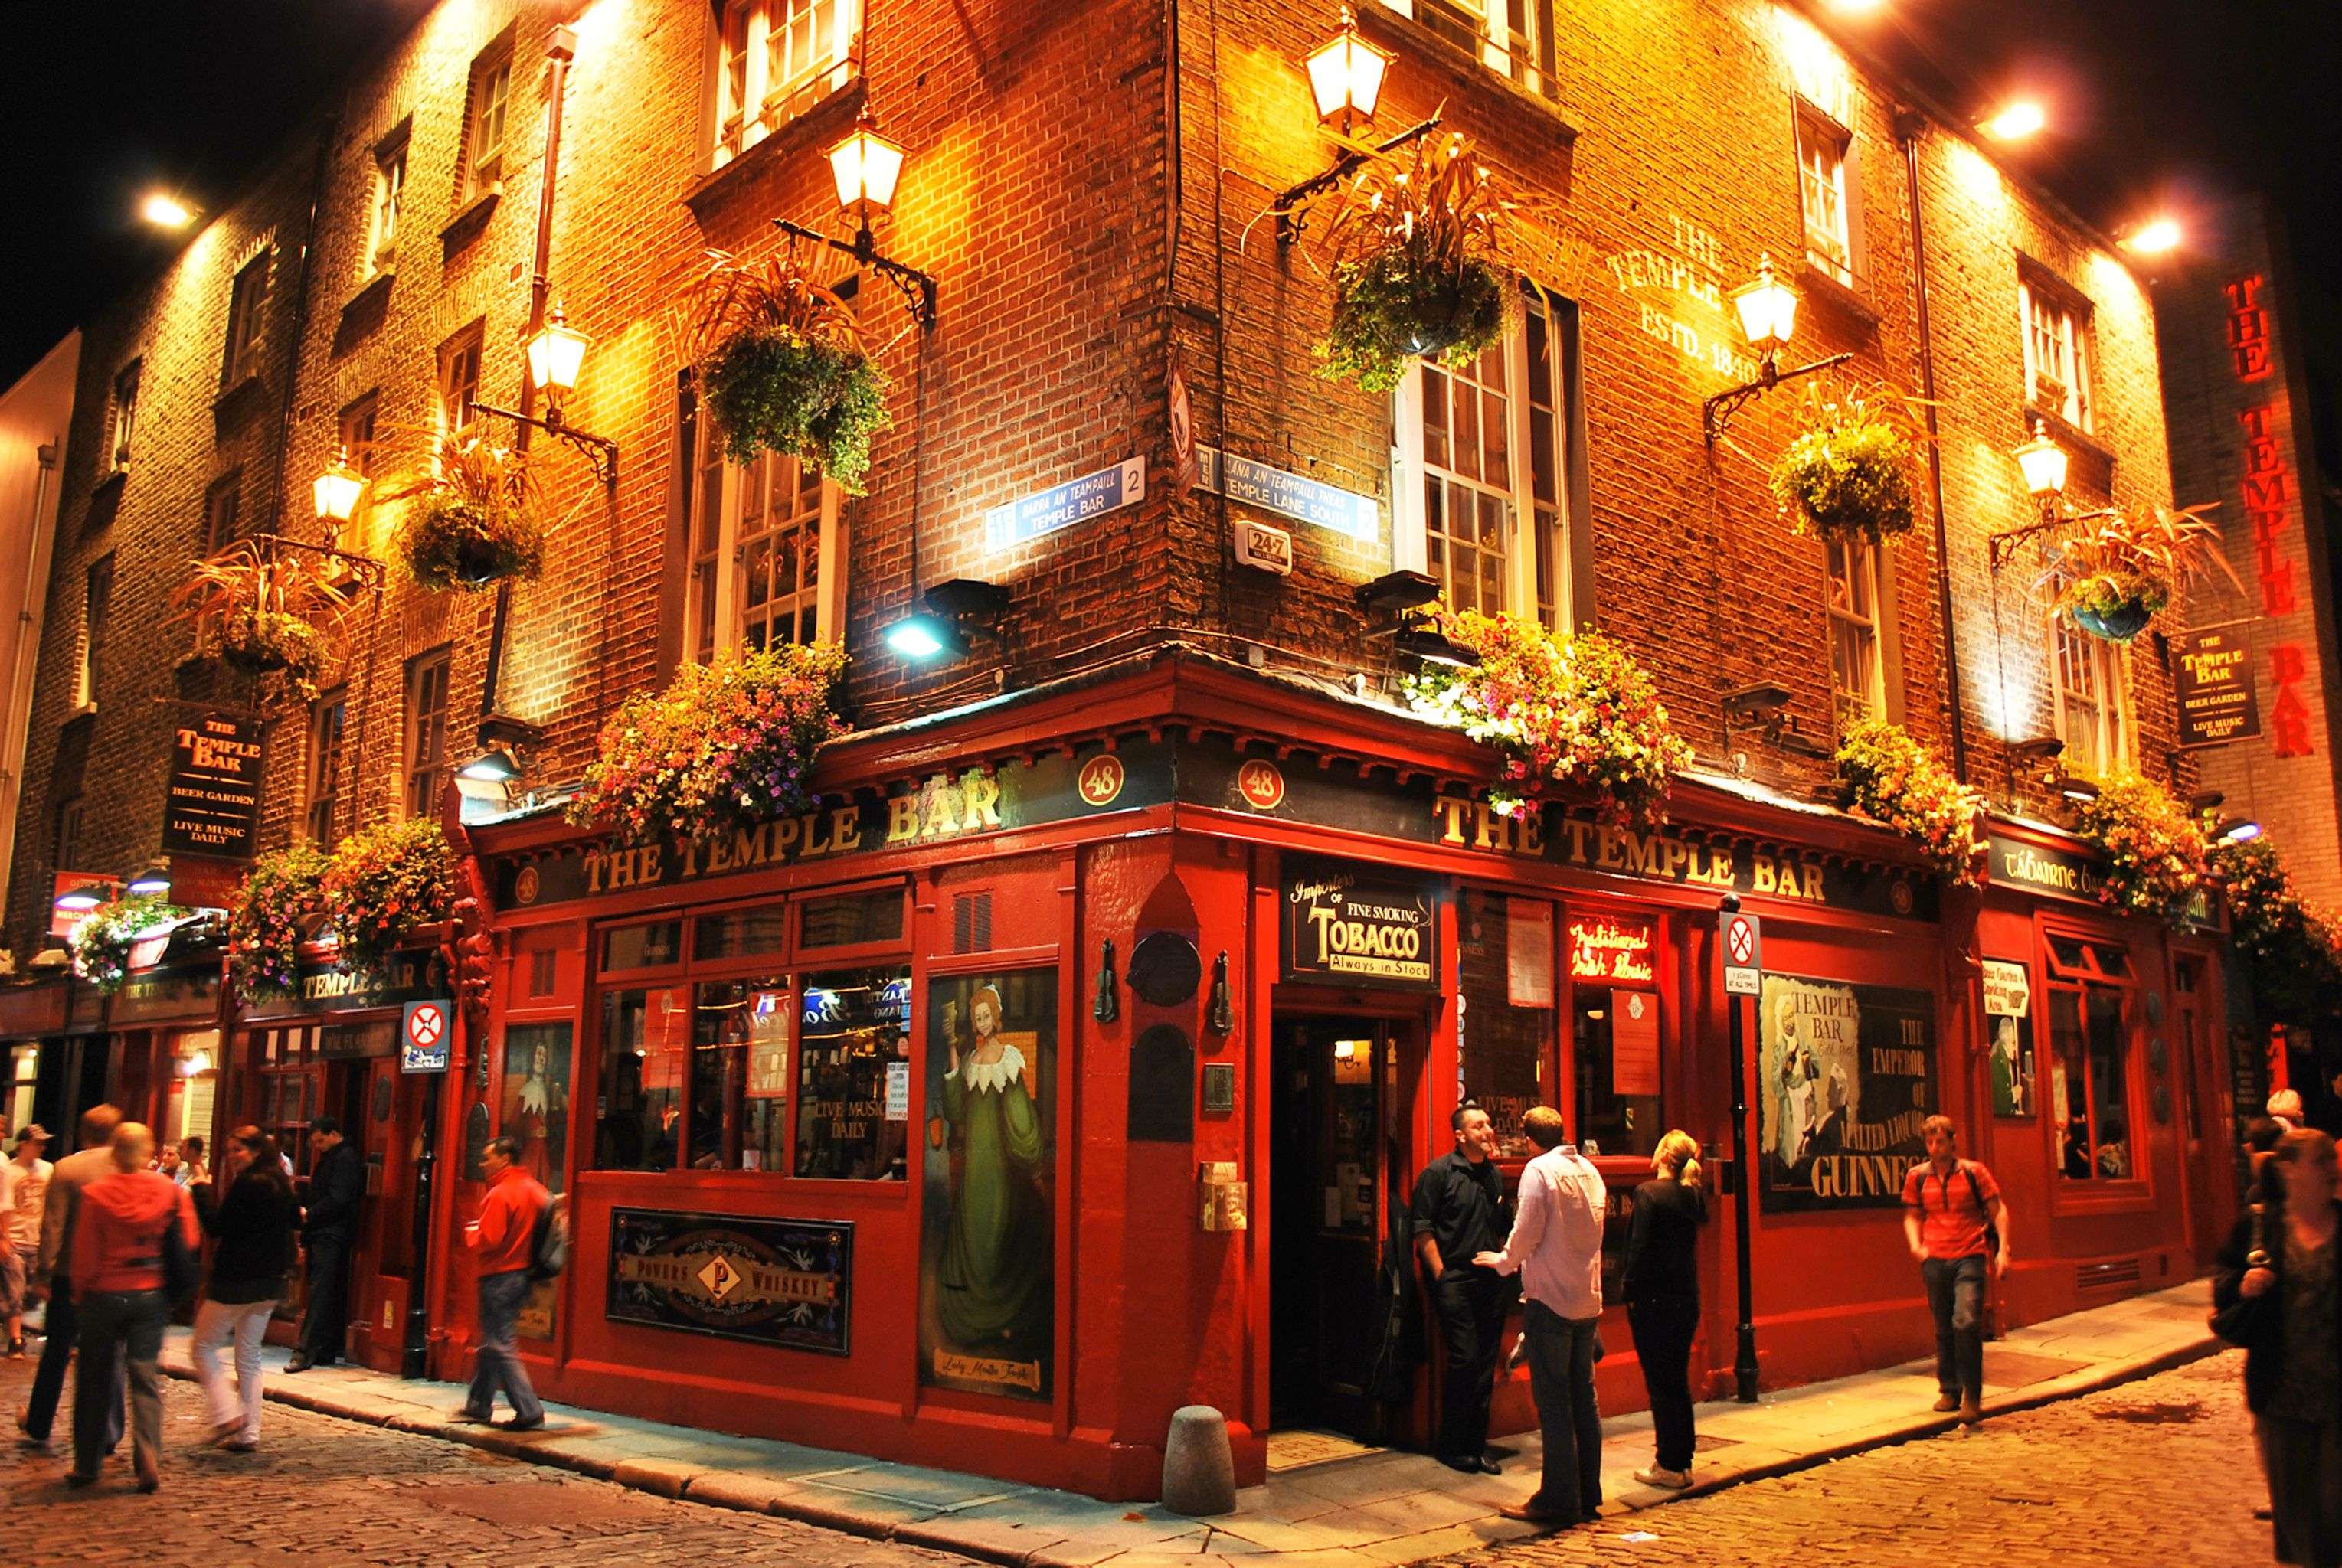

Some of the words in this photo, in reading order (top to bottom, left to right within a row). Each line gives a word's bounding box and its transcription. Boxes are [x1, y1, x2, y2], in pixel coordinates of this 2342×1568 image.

[1669, 211, 1723, 273] THE
[1605, 250, 1722, 311] TEMPLE
[2225, 274, 2272, 380] THE
[1053, 492, 1068, 507] AN
[1070, 472, 1115, 501] TEAMPAILL
[1128, 469, 1140, 492] 2
[1253, 468, 1268, 484] AN
[1271, 475, 1316, 500] TEAMPAILL
[1030, 505, 1075, 531] TEMPLE
[1080, 495, 1104, 514] BAR
[1225, 477, 1269, 503] TEMPLE
[1274, 492, 1305, 515] LANE
[1310, 505, 1350, 528] SOUTH
[2237, 406, 2296, 617] TEMPLE
[2199, 636, 2221, 648] THE
[2181, 650, 2244, 671] TEMPLE
[2196, 668, 2231, 684] BAR
[2185, 697, 2209, 709] BEER
[2210, 692, 2246, 705] GARDEN
[2268, 645, 2314, 759] BAR
[206, 720, 237, 736] THE
[2193, 720, 2213, 732] LIVE
[2215, 717, 2244, 729] MUSIC
[2206, 727, 2232, 737] DAILY
[177, 728, 261, 759] TEMPLE
[191, 748, 242, 772] BAR
[1085, 766, 1115, 797] 48
[1246, 767, 1274, 798] 48
[172, 786, 204, 800] BEER
[206, 792, 255, 805] GARDEN
[174, 820, 203, 832] LIVE
[206, 825, 246, 838] MUSIC
[191, 832, 228, 844] DAILY
[583, 844, 662, 893] THE
[682, 806, 863, 877] TEMPLE
[886, 778, 1001, 842] BAR
[1434, 796, 1545, 857] THE
[1563, 818, 1737, 887] TEMPLE
[1752, 854, 1827, 903] BAR
[1290, 874, 1354, 906] Importers
[1330, 893, 1343, 903] OF
[1347, 902, 1371, 918] FINE
[1372, 906, 1419, 923] SMOKING
[1307, 906, 1420, 963] TOBACCO
[1569, 924, 1648, 950] Traditional
[1332, 956, 1375, 972] Always
[1381, 961, 1391, 972] in
[1395, 962, 1429, 976] Stock
[1571, 949, 1607, 976] Irish
[1611, 953, 1652, 981] Music
[303, 971, 370, 999] TEMPLE
[1792, 991, 1856, 1019] TEMPLE
[1813, 1018, 1843, 1042] BAR
[1900, 1019, 1924, 1045] THE
[1873, 1048, 1925, 1076] EMPEROR
[1477, 1096, 1506, 1112] LIVE
[1912, 1082, 1925, 1107] OF
[816, 1102, 842, 1117] LIVE
[830, 1122, 867, 1139] DAILY
[1840, 1120, 1886, 1151] MALTED
[1811, 1155, 1924, 1197] GUINNE
[752, 1269, 819, 1296] WHISKEY
